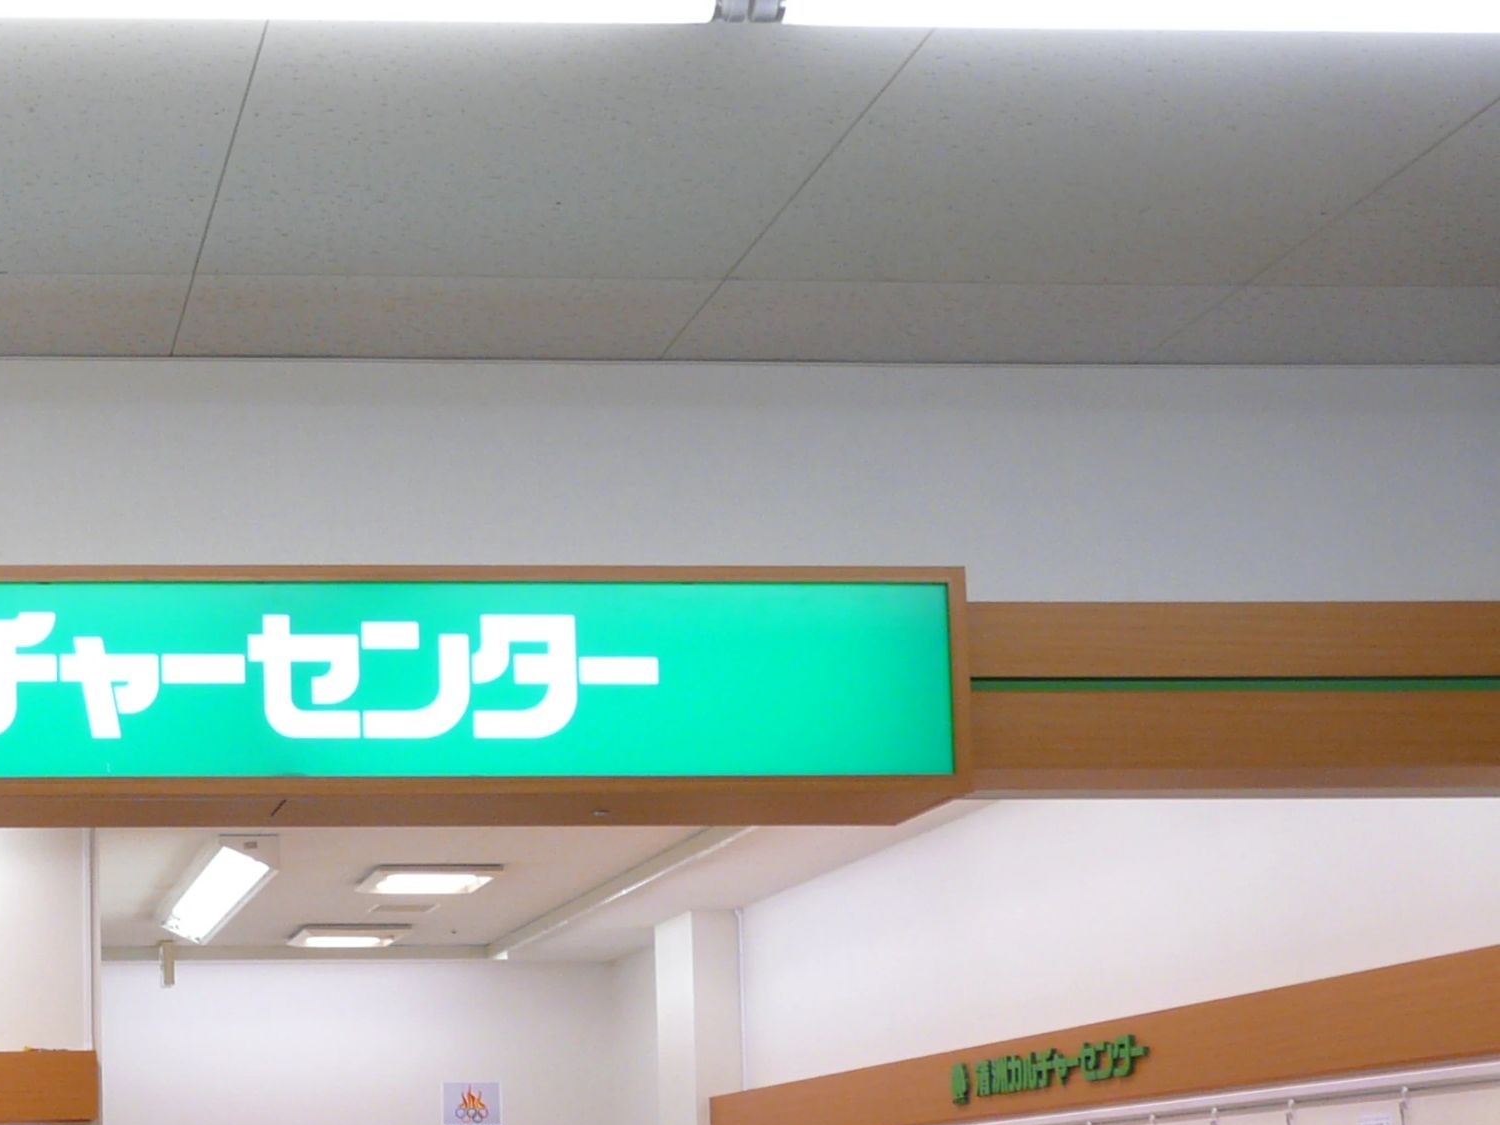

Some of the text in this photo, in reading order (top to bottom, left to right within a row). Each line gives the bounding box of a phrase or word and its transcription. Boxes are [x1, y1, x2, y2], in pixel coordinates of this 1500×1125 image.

[974, 1033, 1150, 1098] 清洲カルチャーセンター
